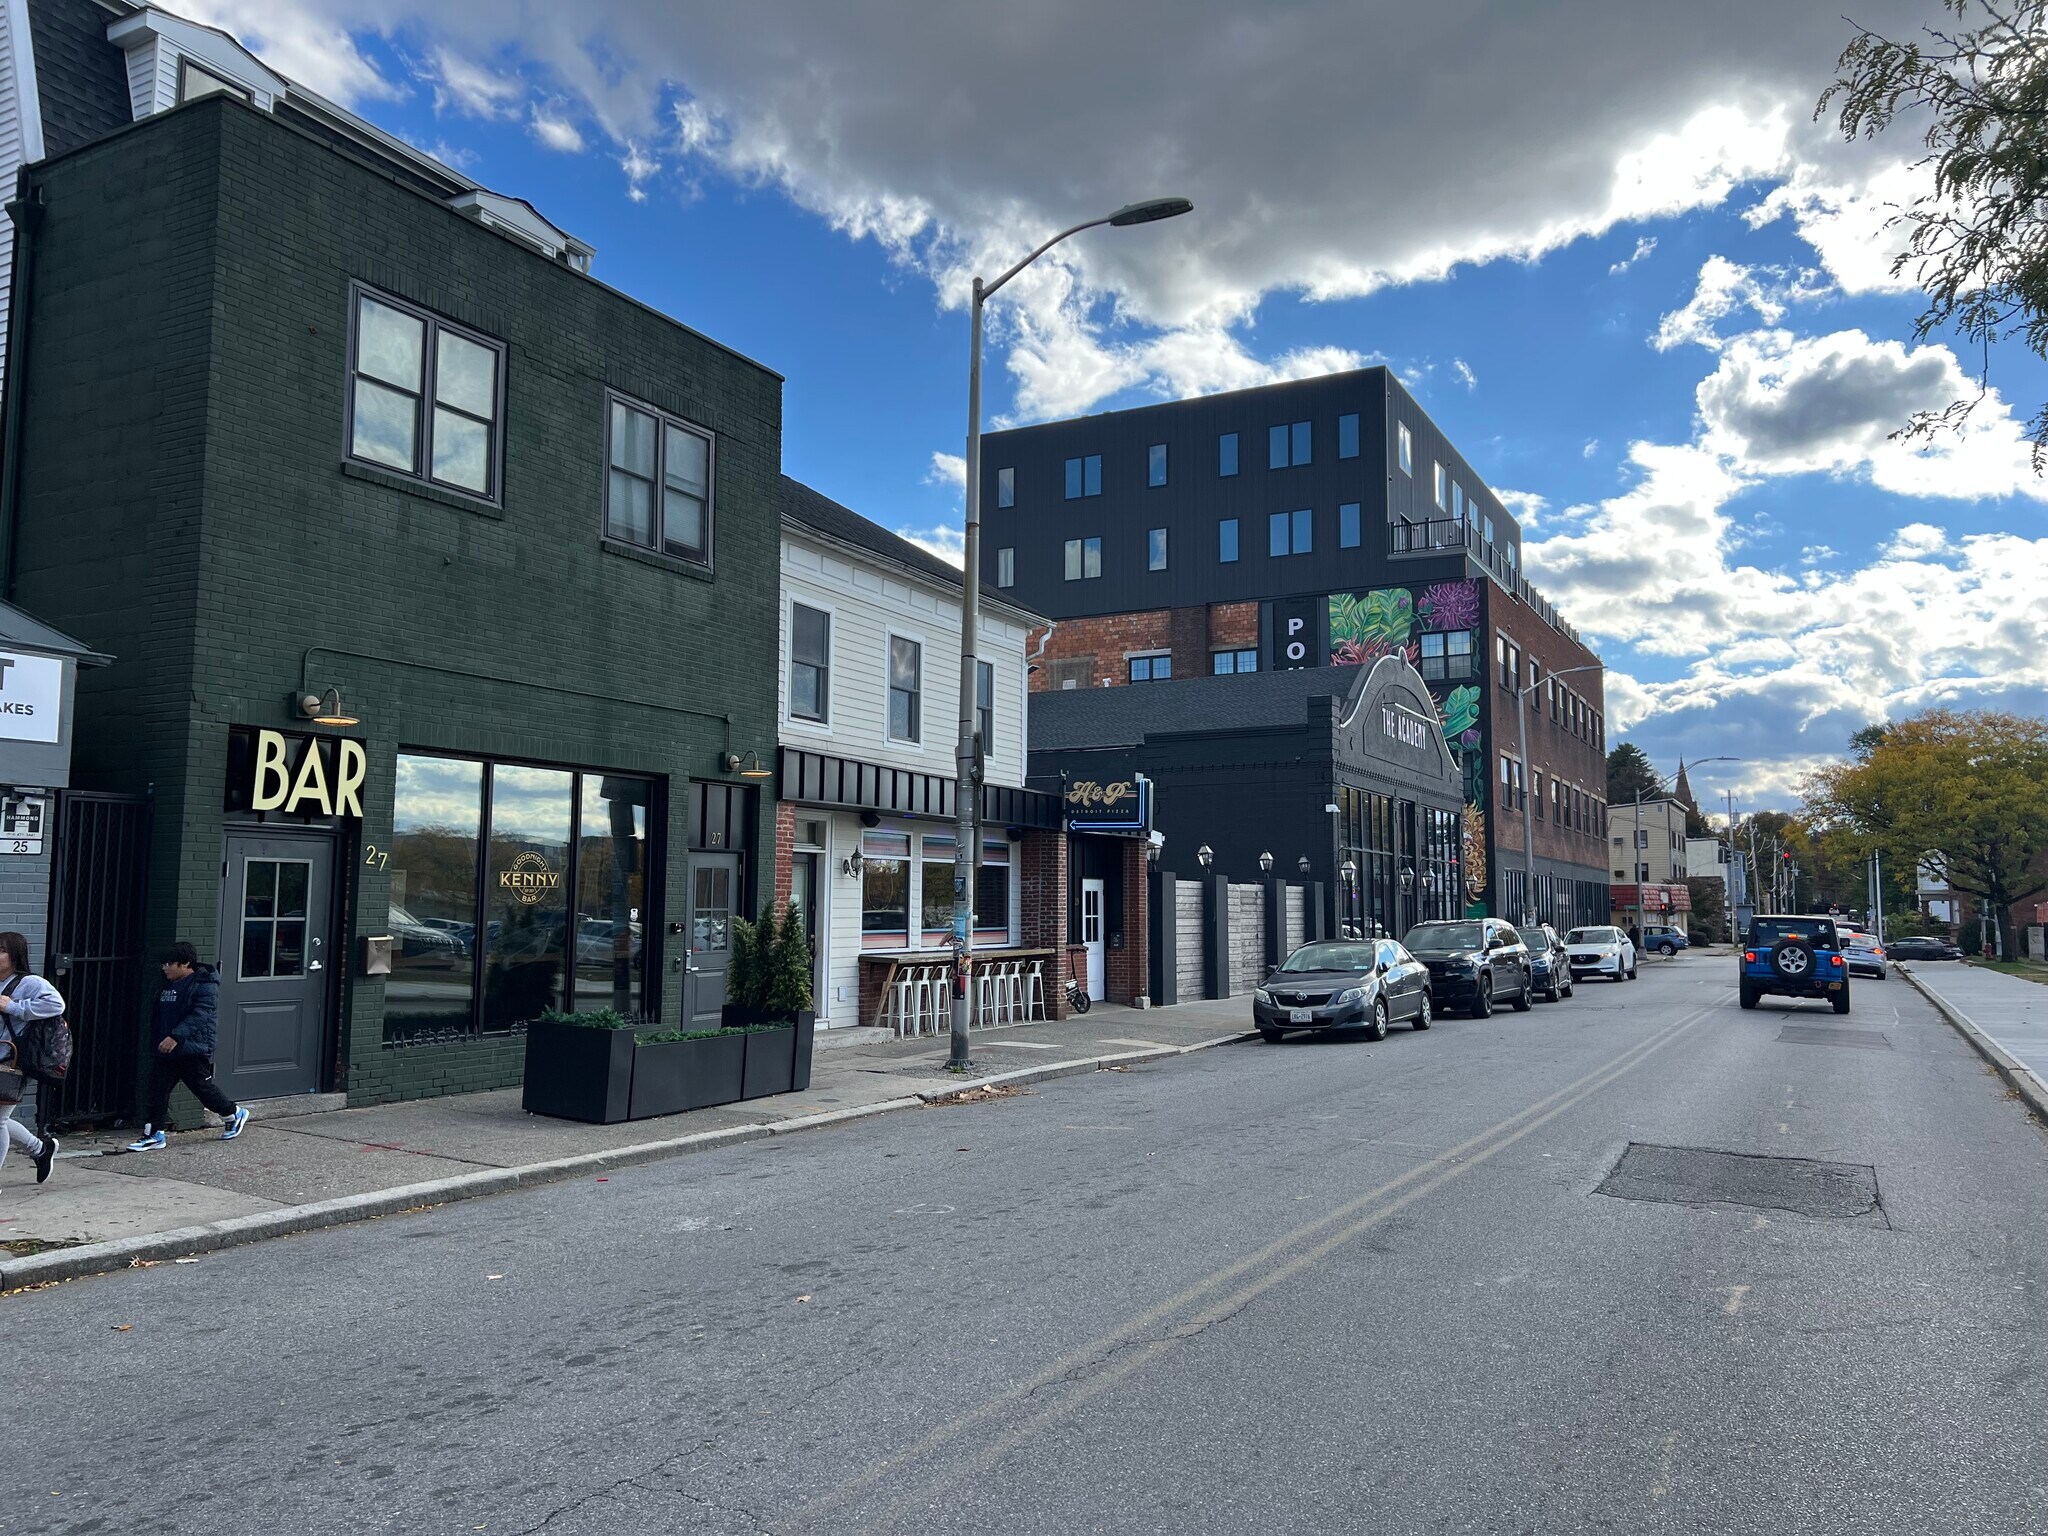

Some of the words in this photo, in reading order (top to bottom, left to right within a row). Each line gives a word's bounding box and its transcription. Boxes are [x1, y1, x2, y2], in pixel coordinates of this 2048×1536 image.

[1286, 618, 1306, 671] PO
[0, 702, 34, 716] KES
[1382, 707, 1395, 738] THE
[1397, 714, 1426, 750] ACADEMY
[252, 729, 367, 818] BAR
[1068, 781, 1132, 808] H&P
[6, 814, 39, 822] HAMMOND
[12, 840, 28, 853] 25
[711, 832, 722, 845] 27
[365, 844, 388, 872] 27
[513, 853, 548, 871] GOODNIGHT
[500, 872, 558, 887] KENNY
[521, 894, 537, 903] BAR
